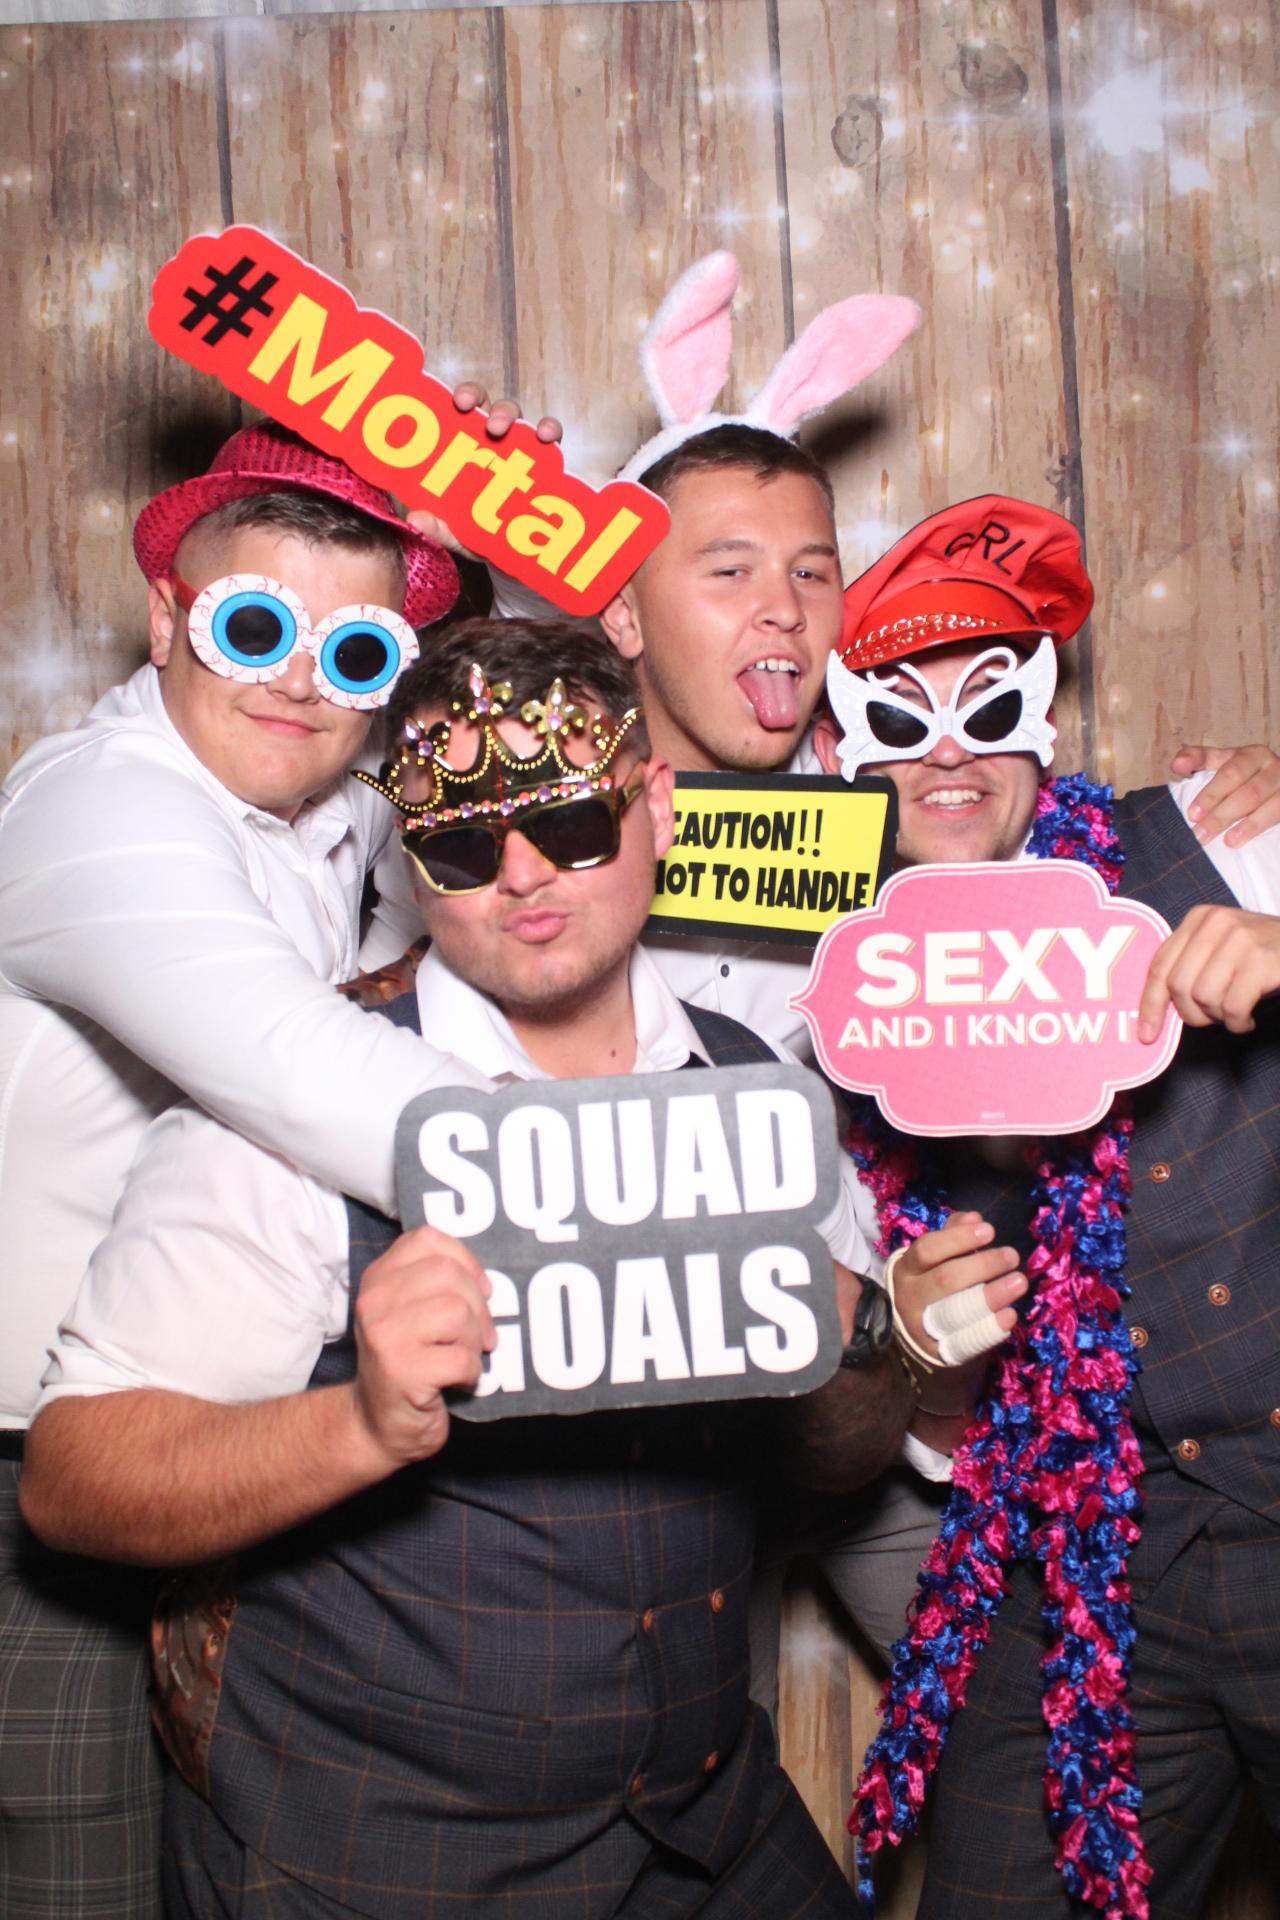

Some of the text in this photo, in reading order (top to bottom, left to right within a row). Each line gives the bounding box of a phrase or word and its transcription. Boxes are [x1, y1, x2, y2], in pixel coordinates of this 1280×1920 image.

[178, 255, 642, 593] #Mortal
[712, 863, 750, 902] TO
[755, 866, 871, 913] HANDLE
[854, 925, 1140, 1009] SEXY
[837, 1010, 1139, 1050] AND I KNOW I
[418, 1088, 818, 1243] SQUAD
